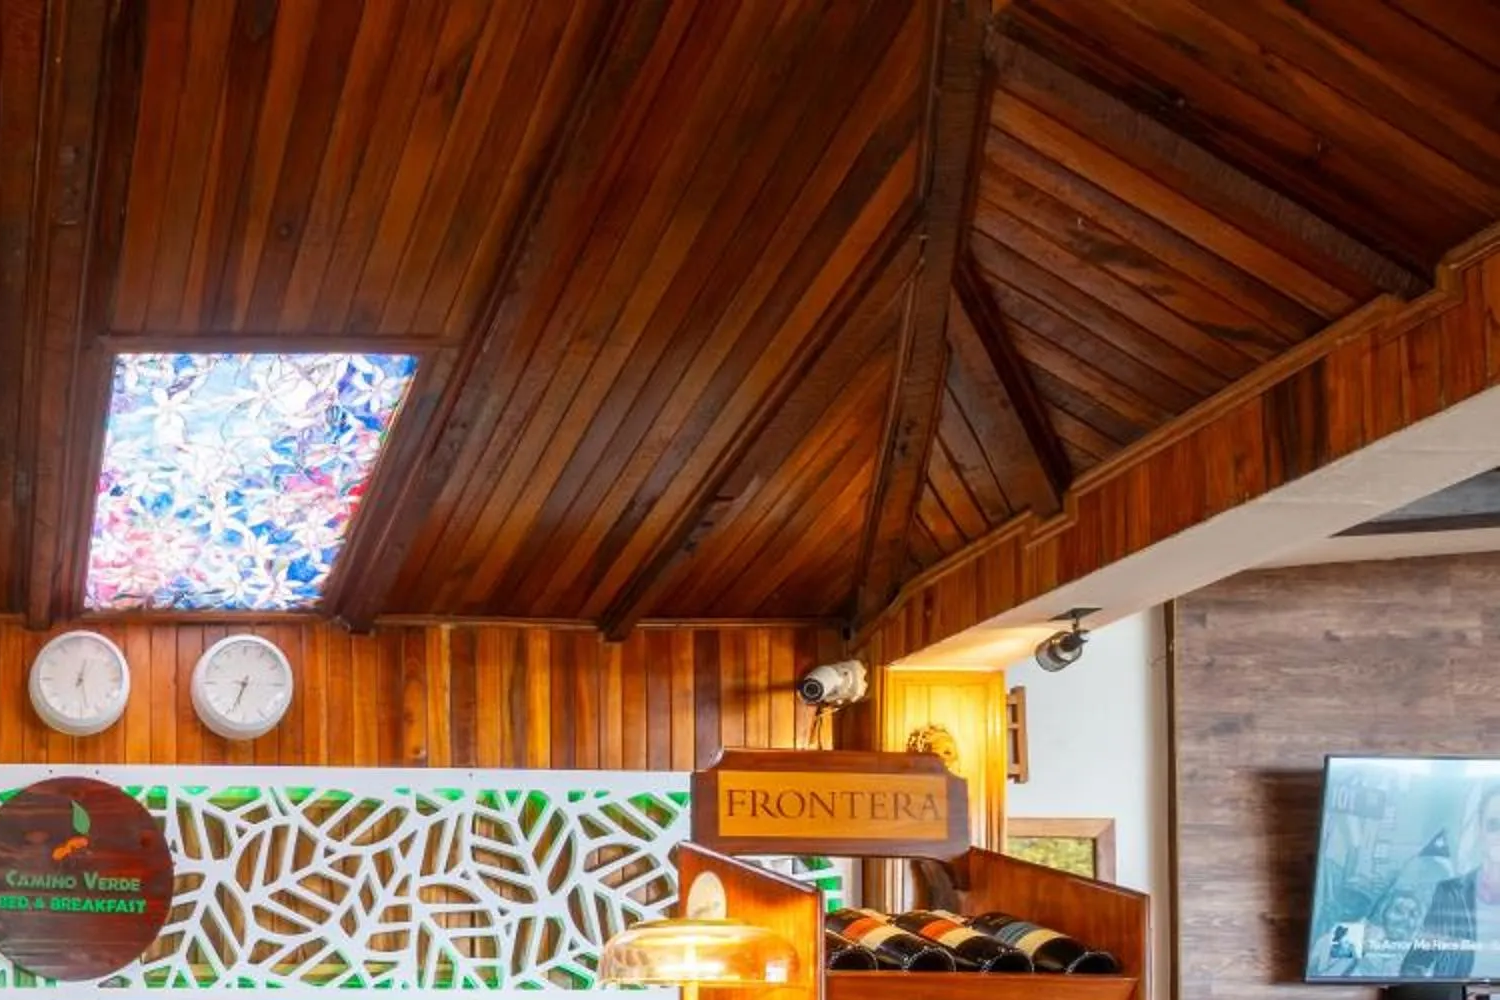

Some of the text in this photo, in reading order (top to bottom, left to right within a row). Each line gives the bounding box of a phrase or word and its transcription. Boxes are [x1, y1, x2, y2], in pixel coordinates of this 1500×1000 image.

[726, 788, 942, 821] FRONTERA
[5, 869, 142, 892] CAMINO VERDE
[50, 895, 147, 914] BREAKFAST
